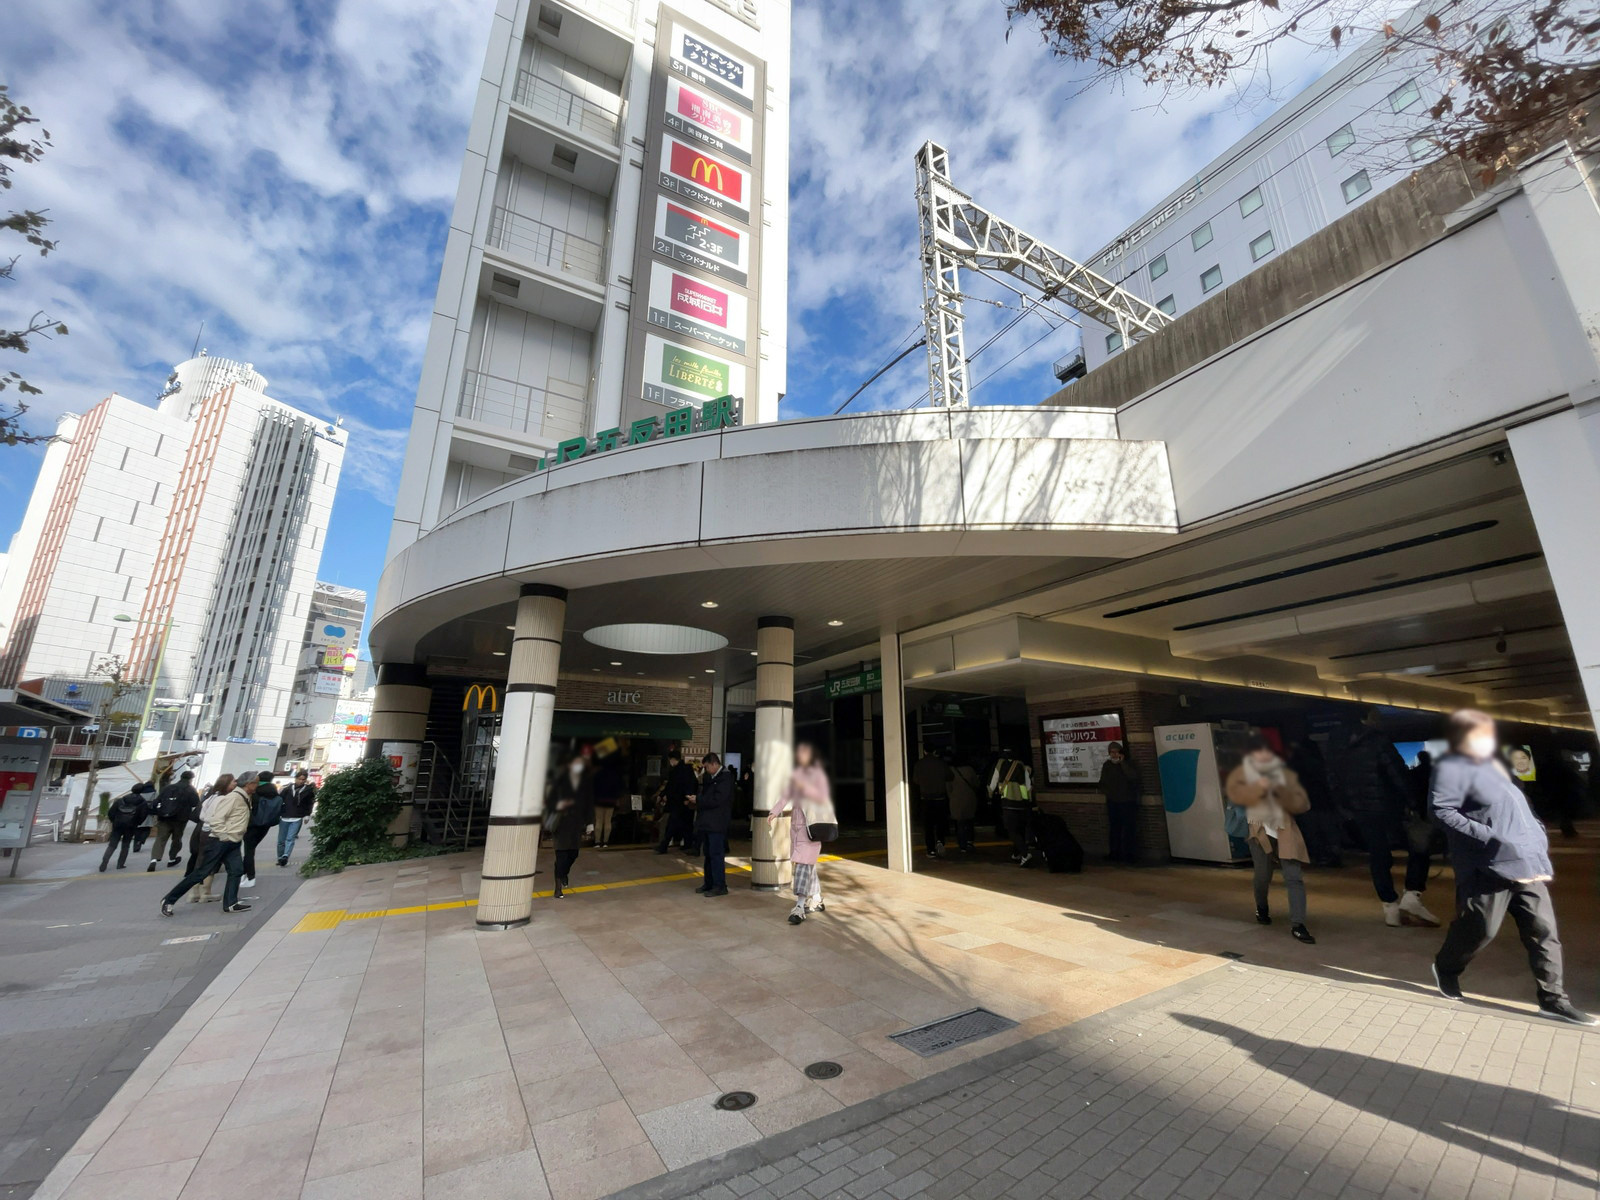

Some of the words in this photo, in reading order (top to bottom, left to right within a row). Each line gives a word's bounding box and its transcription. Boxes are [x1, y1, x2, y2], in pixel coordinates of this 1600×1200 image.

[672, 60, 684, 71] 5F
[668, 117, 680, 127] 4F
[662, 176, 675, 188] 3F
[683, 187, 723, 208] マクドナルド
[1103, 229, 1151, 266] HOTEL
[1152, 190, 1196, 230] METS
[657, 240, 670, 253] 2F
[679, 250, 720, 272] マクドナルド
[653, 311, 665, 324] 1F
[674, 321, 739, 350] スーパーマーケット
[648, 387, 660, 399] 1F
[830, 681, 841, 693] JR
[607, 689, 641, 704] atré
[1165, 732, 1196, 742] acure
